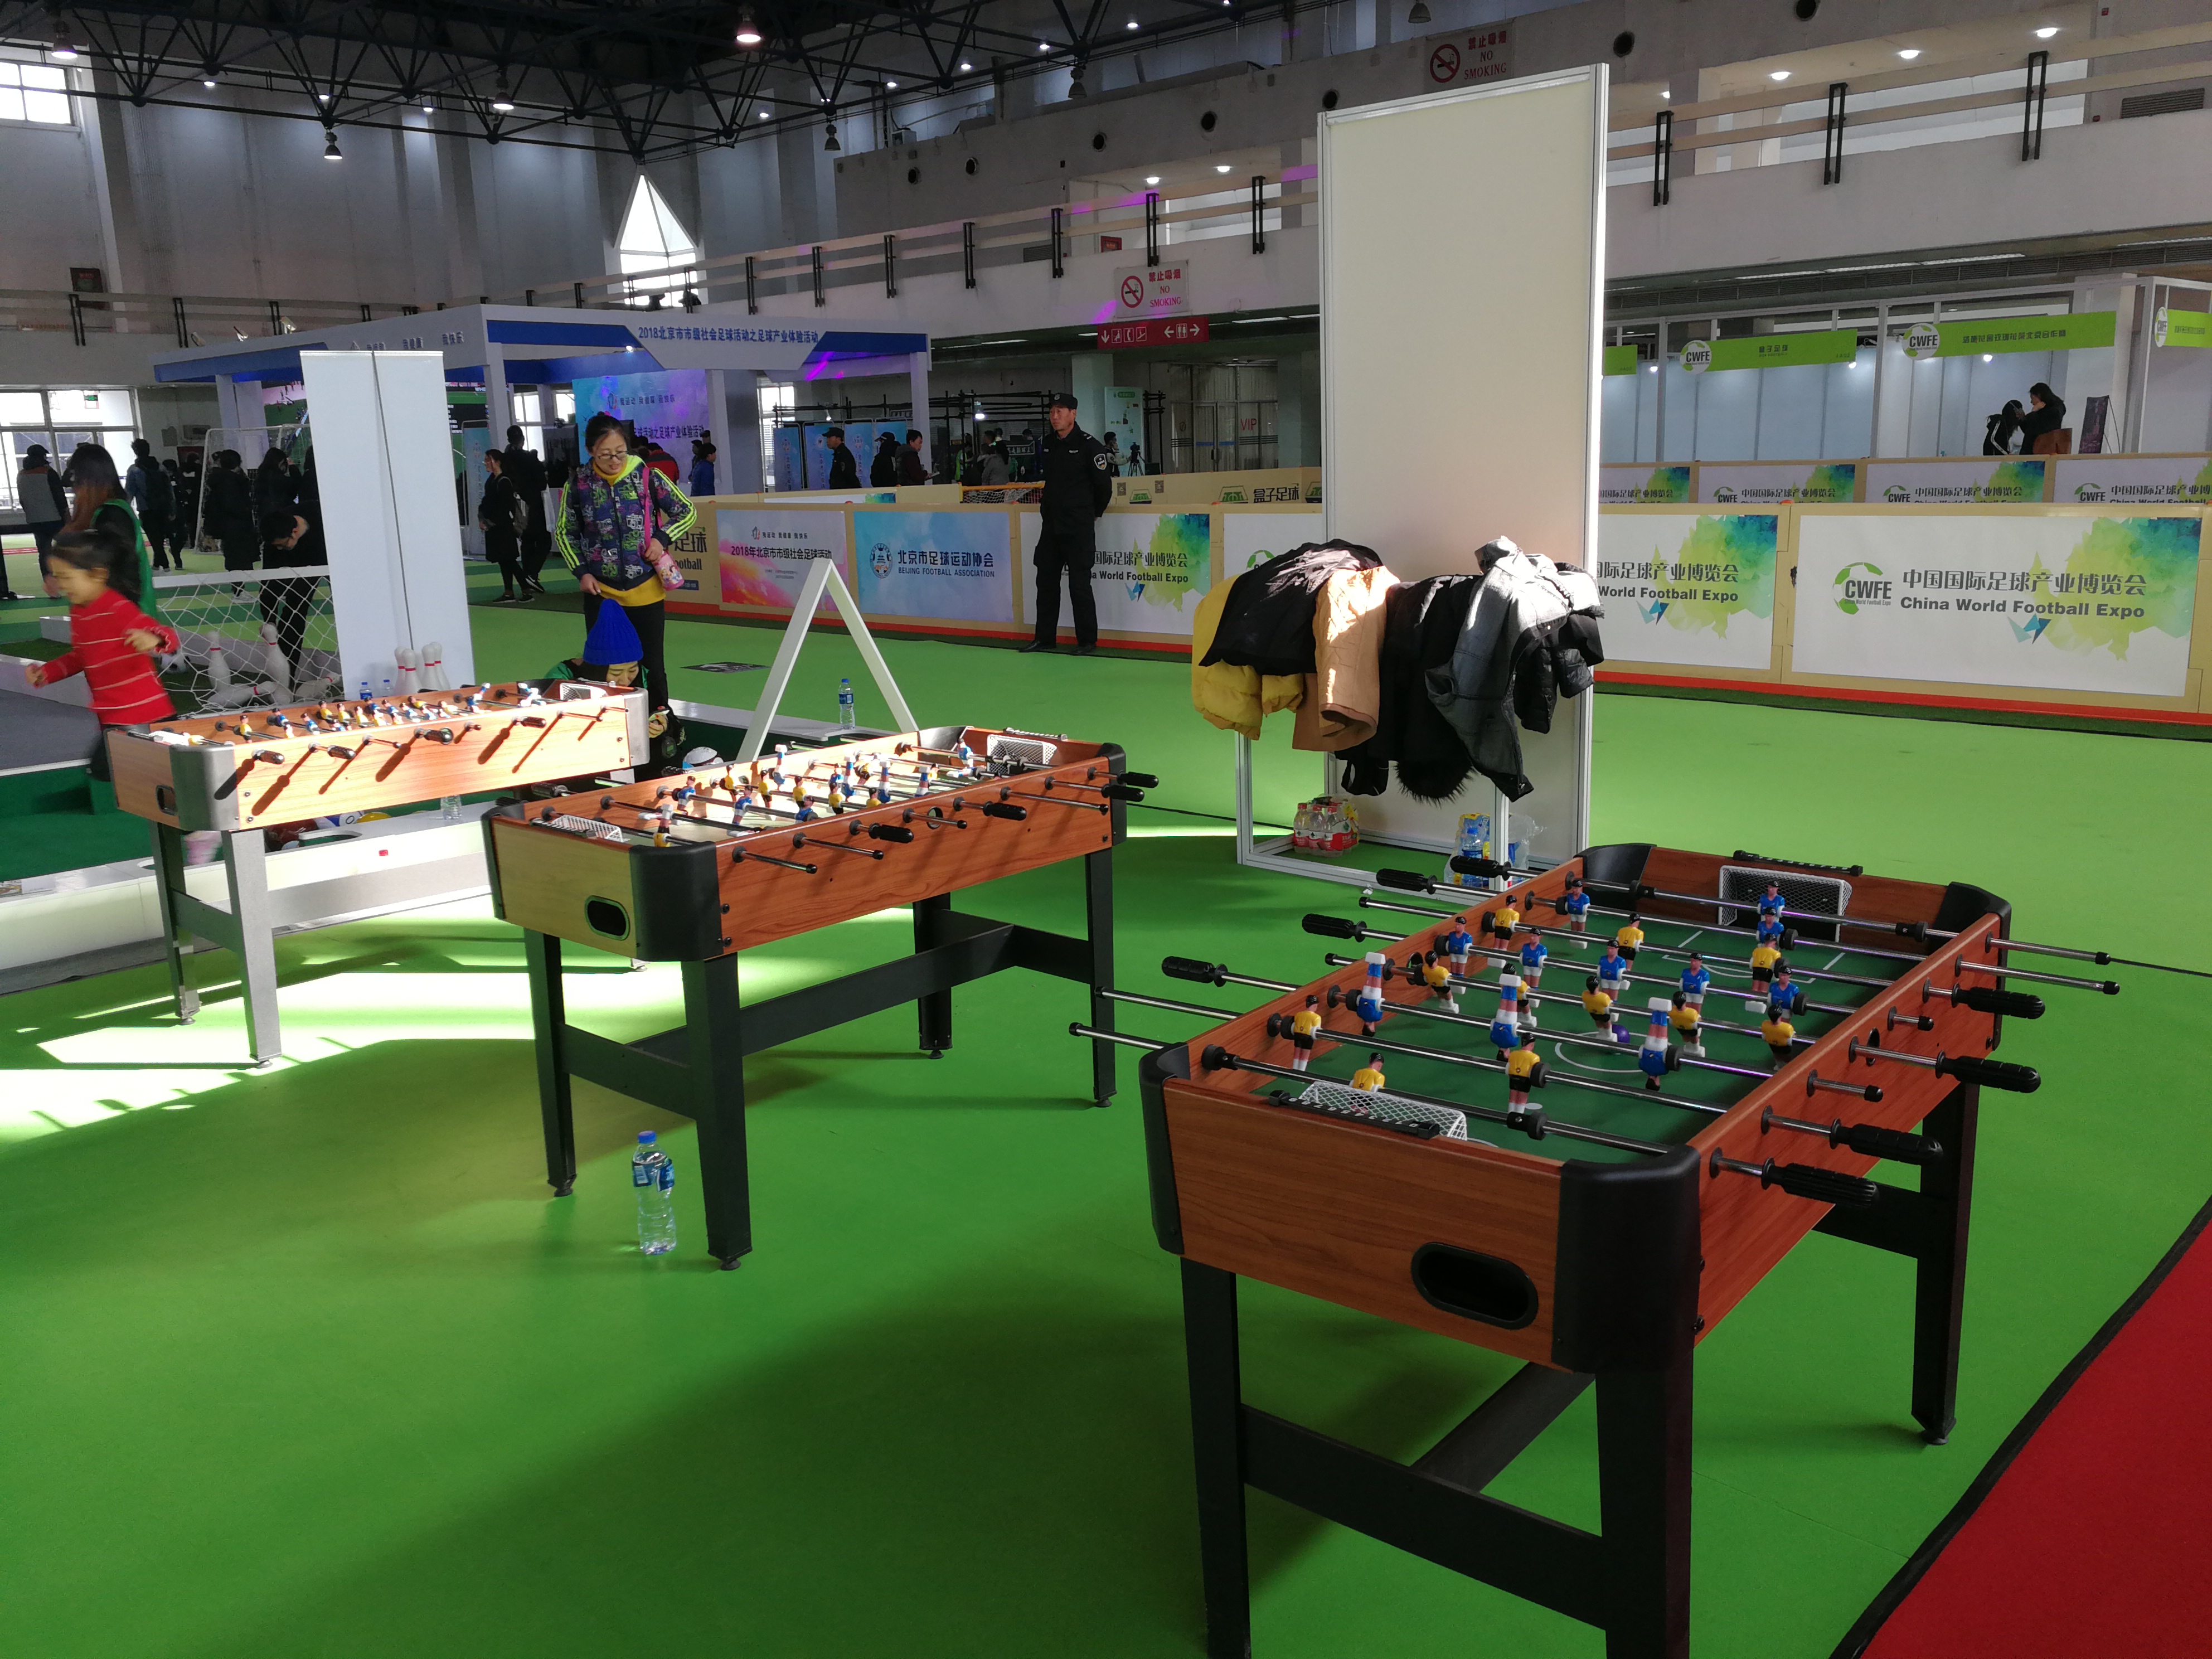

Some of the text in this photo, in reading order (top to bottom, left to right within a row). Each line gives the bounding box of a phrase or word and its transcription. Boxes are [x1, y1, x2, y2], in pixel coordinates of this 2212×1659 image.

[1468, 31, 1506, 50] 禁止吸烟
[1480, 50, 1493, 62] NO
[1464, 62, 1506, 79] SMOKING
[1149, 269, 1181, 282] 禁止吸烟
[1160, 285, 1170, 294] NO
[1150, 297, 1181, 307] SMOKING
[1909, 334, 1938, 347] CWFE
[1686, 351, 1710, 362] CWFE
[1240, 418, 1257, 430] VIP
[1253, 486, 1299, 503] 盒子足球
[1718, 494, 1737, 502] CWFE
[1742, 488, 1836, 498] 中国国际足球产业博览会
[1888, 493, 1910, 502] CWFE
[1915, 487, 2022, 497] 中国国际足球产业博览会
[2080, 492, 2106, 502] CWFE
[731, 546, 832, 560] 2018年北京市市级社会足球活动
[898, 550, 993, 567] 北京市足球运动协会
[675, 558, 702, 570] ootball
[923, 567, 952, 576] FOOTBALL
[954, 569, 995, 578] ASSOCIATION
[1100, 570, 1124, 580] World
[1127, 571, 1163, 582] Football
[1166, 573, 1189, 584] Expo
[1903, 569, 2146, 596] 中国国际足球产业博览会
[1599, 586, 1738, 603] World Football Expo
[1845, 580, 1892, 599] CWFE
[1900, 596, 2145, 619] China World Football Expo
